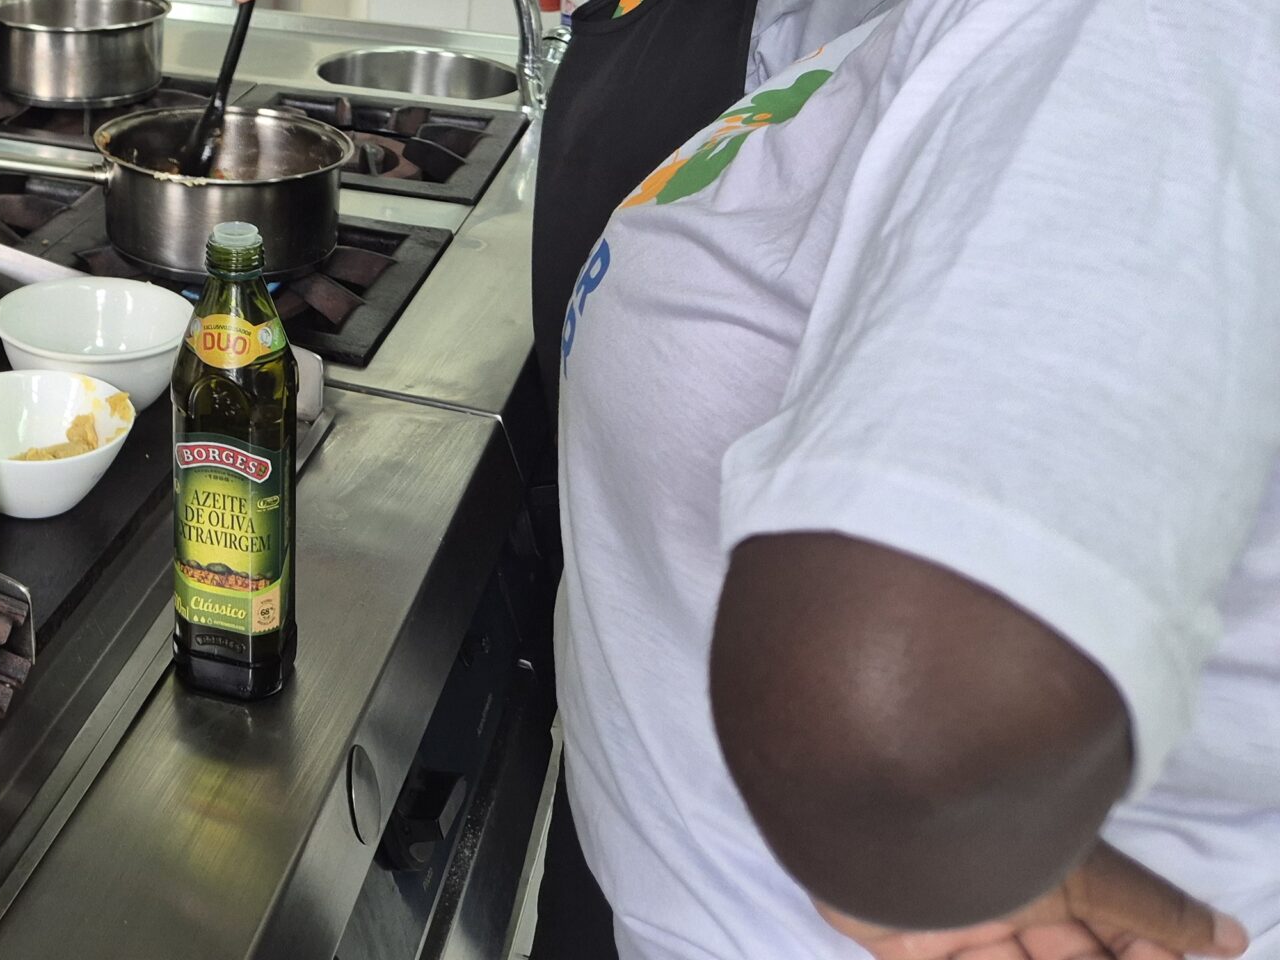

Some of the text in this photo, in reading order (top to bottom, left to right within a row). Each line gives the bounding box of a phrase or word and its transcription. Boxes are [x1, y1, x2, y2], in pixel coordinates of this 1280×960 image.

[203, 332, 247, 355] DUO
[182, 448, 258, 474] BORGES
[190, 489, 248, 515] AZEITE
[185, 504, 256, 534] DE OLIVA
[190, 596, 247, 619] Clássico
